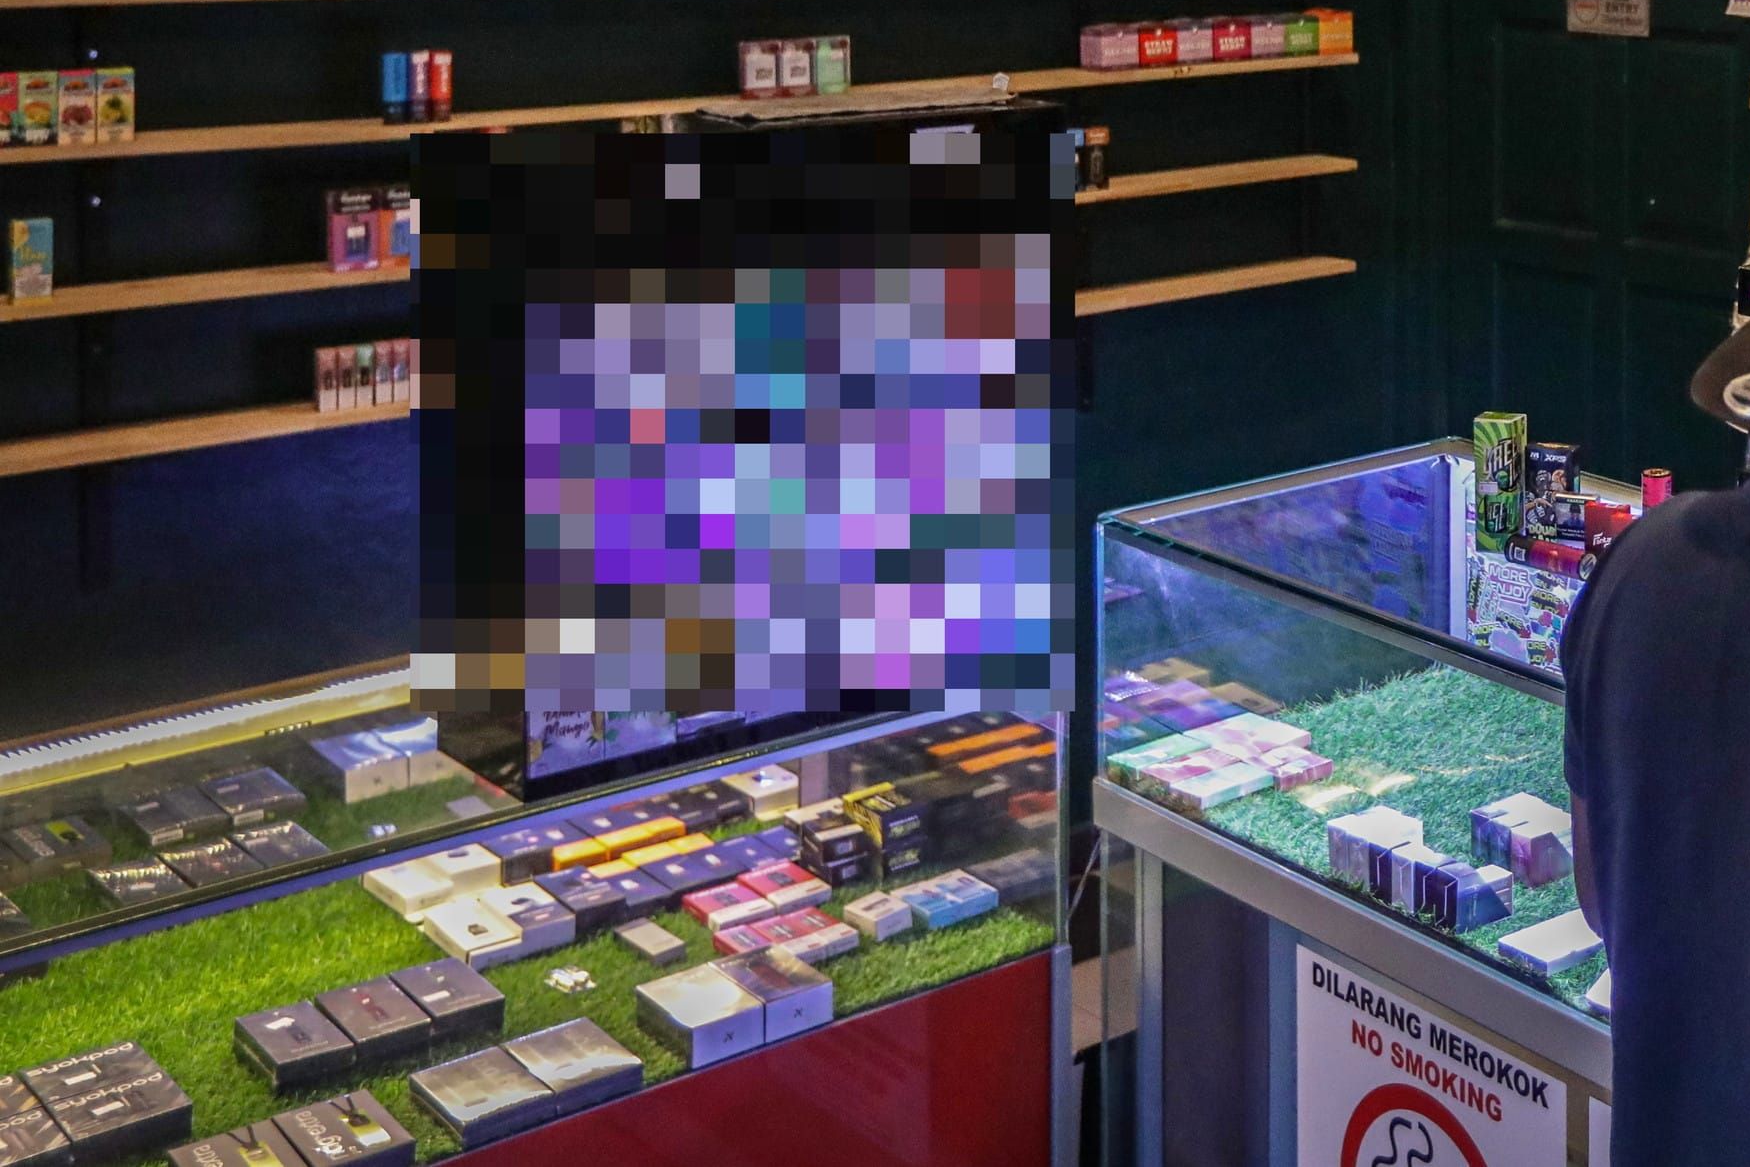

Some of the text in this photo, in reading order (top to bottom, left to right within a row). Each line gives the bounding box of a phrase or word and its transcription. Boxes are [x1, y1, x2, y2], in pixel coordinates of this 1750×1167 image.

[1488, 563, 1528, 583] MORE
[1490, 581, 1531, 600] ENJOY
[1312, 961, 1550, 1109] DILARANG MEROKOK
[26, 1041, 135, 1078] syokpod
[1351, 1018, 1503, 1122] NO SMOKING
[53, 1071, 164, 1111] syokpod
